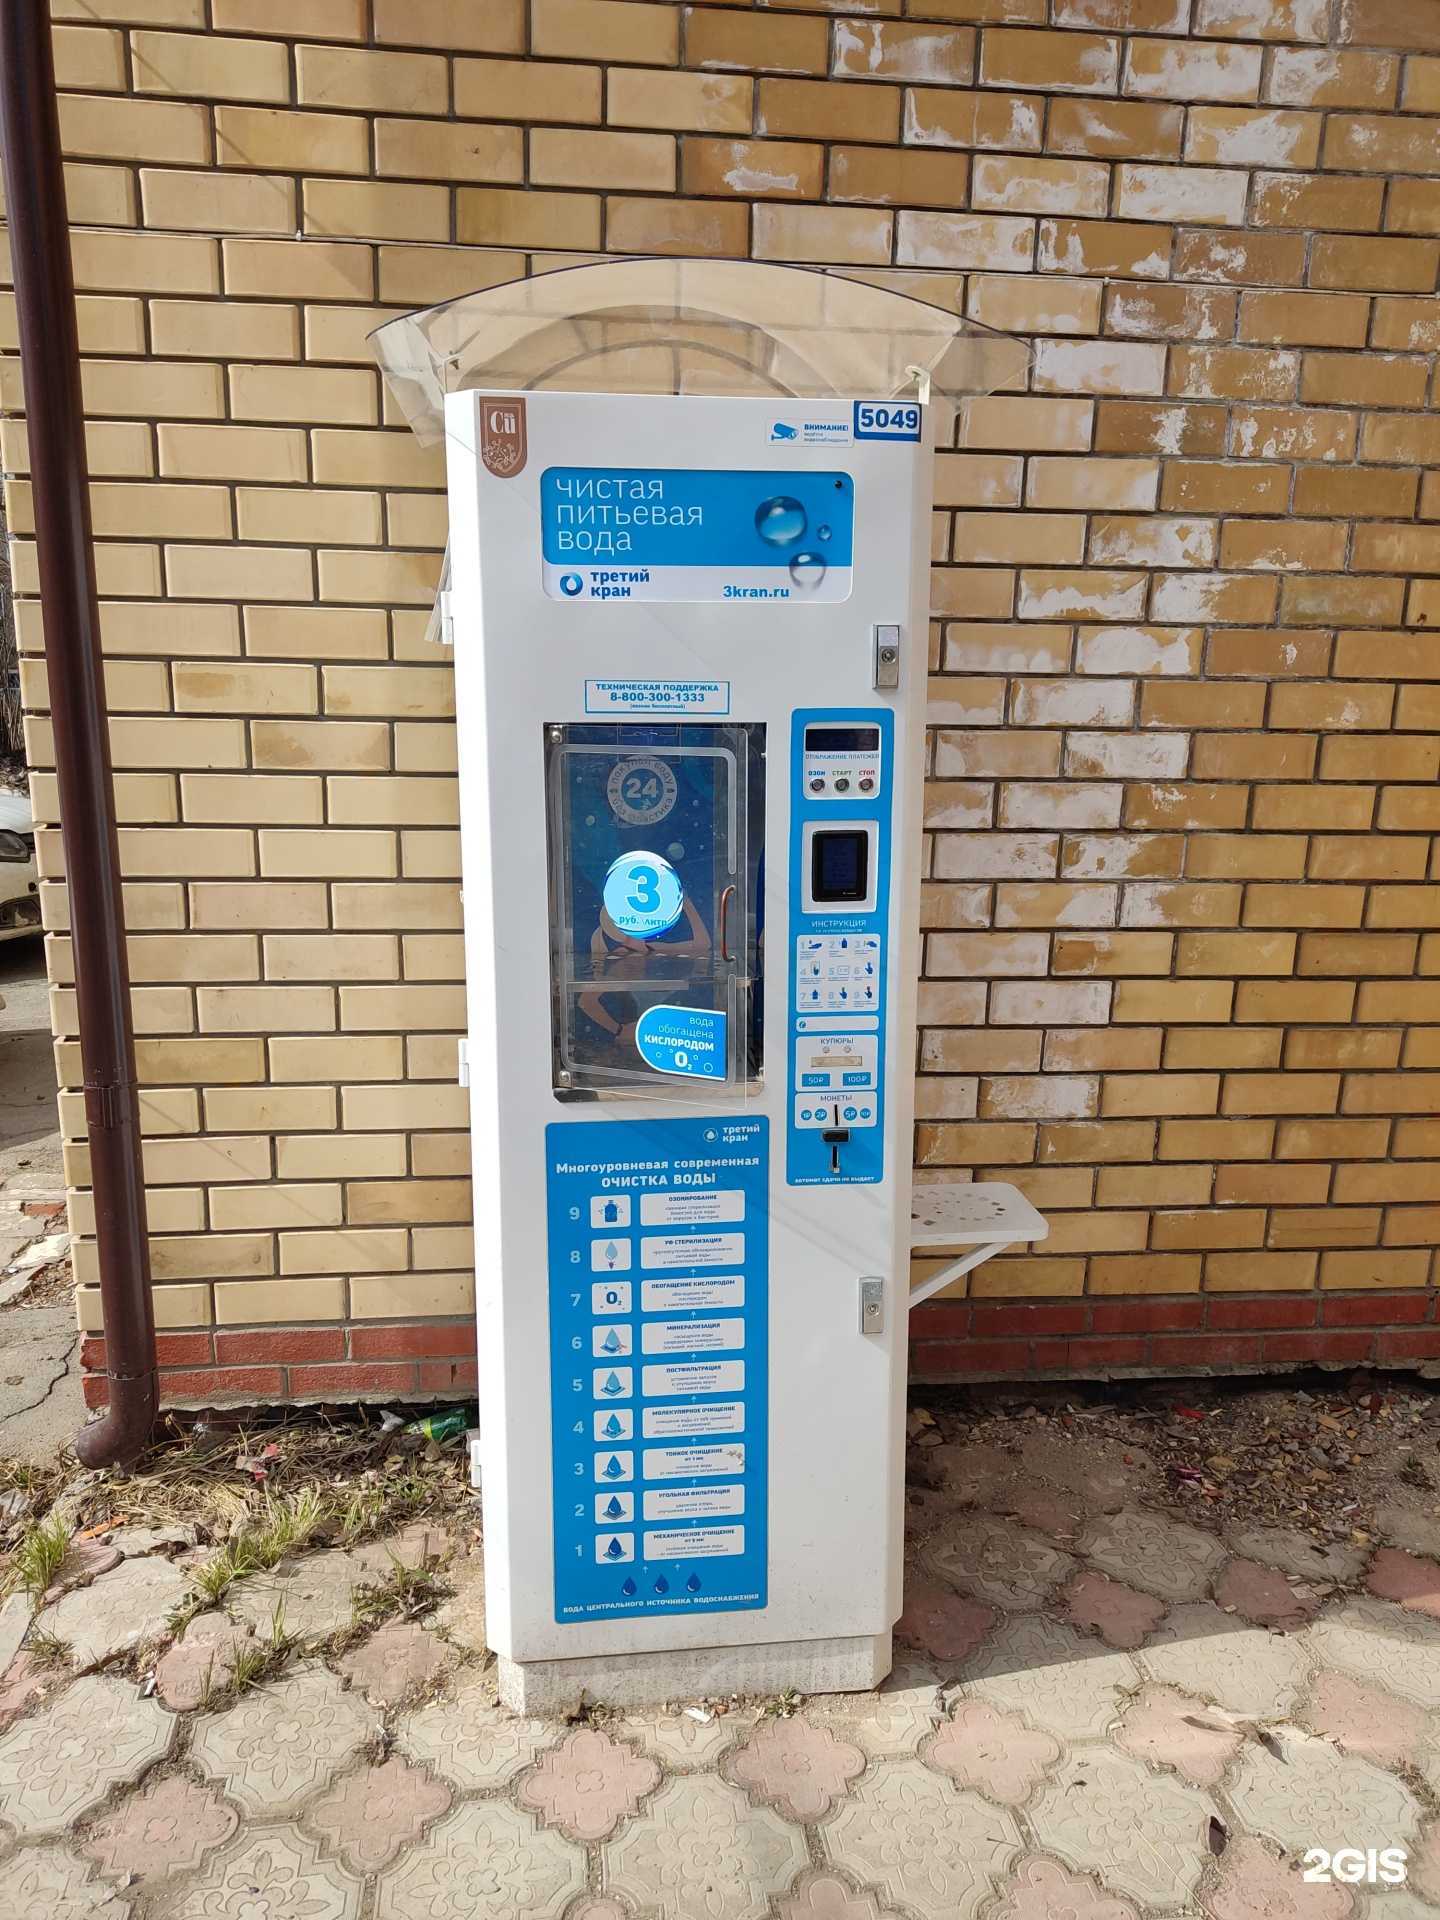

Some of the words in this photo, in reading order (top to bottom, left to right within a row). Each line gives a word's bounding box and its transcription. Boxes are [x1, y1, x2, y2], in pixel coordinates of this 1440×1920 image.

[861, 408, 918, 429] 5049
[556, 478, 664, 499] чистая
[557, 504, 703, 526] питьевая
[558, 530, 633, 557] вода
[590, 569, 650, 583] третий
[591, 586, 631, 600] кран
[723, 585, 790, 598] 3kran.ru
[596, 683, 661, 691] ТЕХНИЧЕСКАЯ
[663, 684, 719, 692] ПОДДЕРЖКА
[610, 692, 705, 702] 8-800-300-1333
[627, 778, 657, 799] 24
[627, 865, 661, 913] 3
[619, 915, 639, 925] руб.
[811, 919, 867, 928] ИНСТРУКЦИЯ
[689, 1017, 714, 1028] вода
[658, 1024, 714, 1039] обогащена
[644, 1034, 714, 1051] КИСЛОРОДОМ
[722, 1124, 760, 1135] третий
[722, 1135, 749, 1144] кран
[556, 1159, 669, 1175] Многоуровневая
[674, 1156, 760, 1170] современная
[601, 1174, 669, 1188] ОЧИСТКА
[673, 1172, 717, 1186] ВОДЫ
[569, 1207, 581, 1220] 9
[570, 1250, 581, 1263] 8
[570, 1294, 581, 1307] 7
[571, 1336, 582, 1349] 6
[572, 1379, 583, 1391] 5
[573, 1421, 584, 1433] 4
[574, 1463, 584, 1475] 3
[575, 1504, 585, 1516] 2
[575, 1545, 583, 1556] 1
[563, 1605, 584, 1613] ВОДА
[586, 1601, 644, 1611] ЦЕНТРАЛЬНОГО
[646, 1597, 691, 1607] ИСТОЧНИКА
[693, 1593, 760, 1603] ВОДОСНАБЖЕНИЯ
